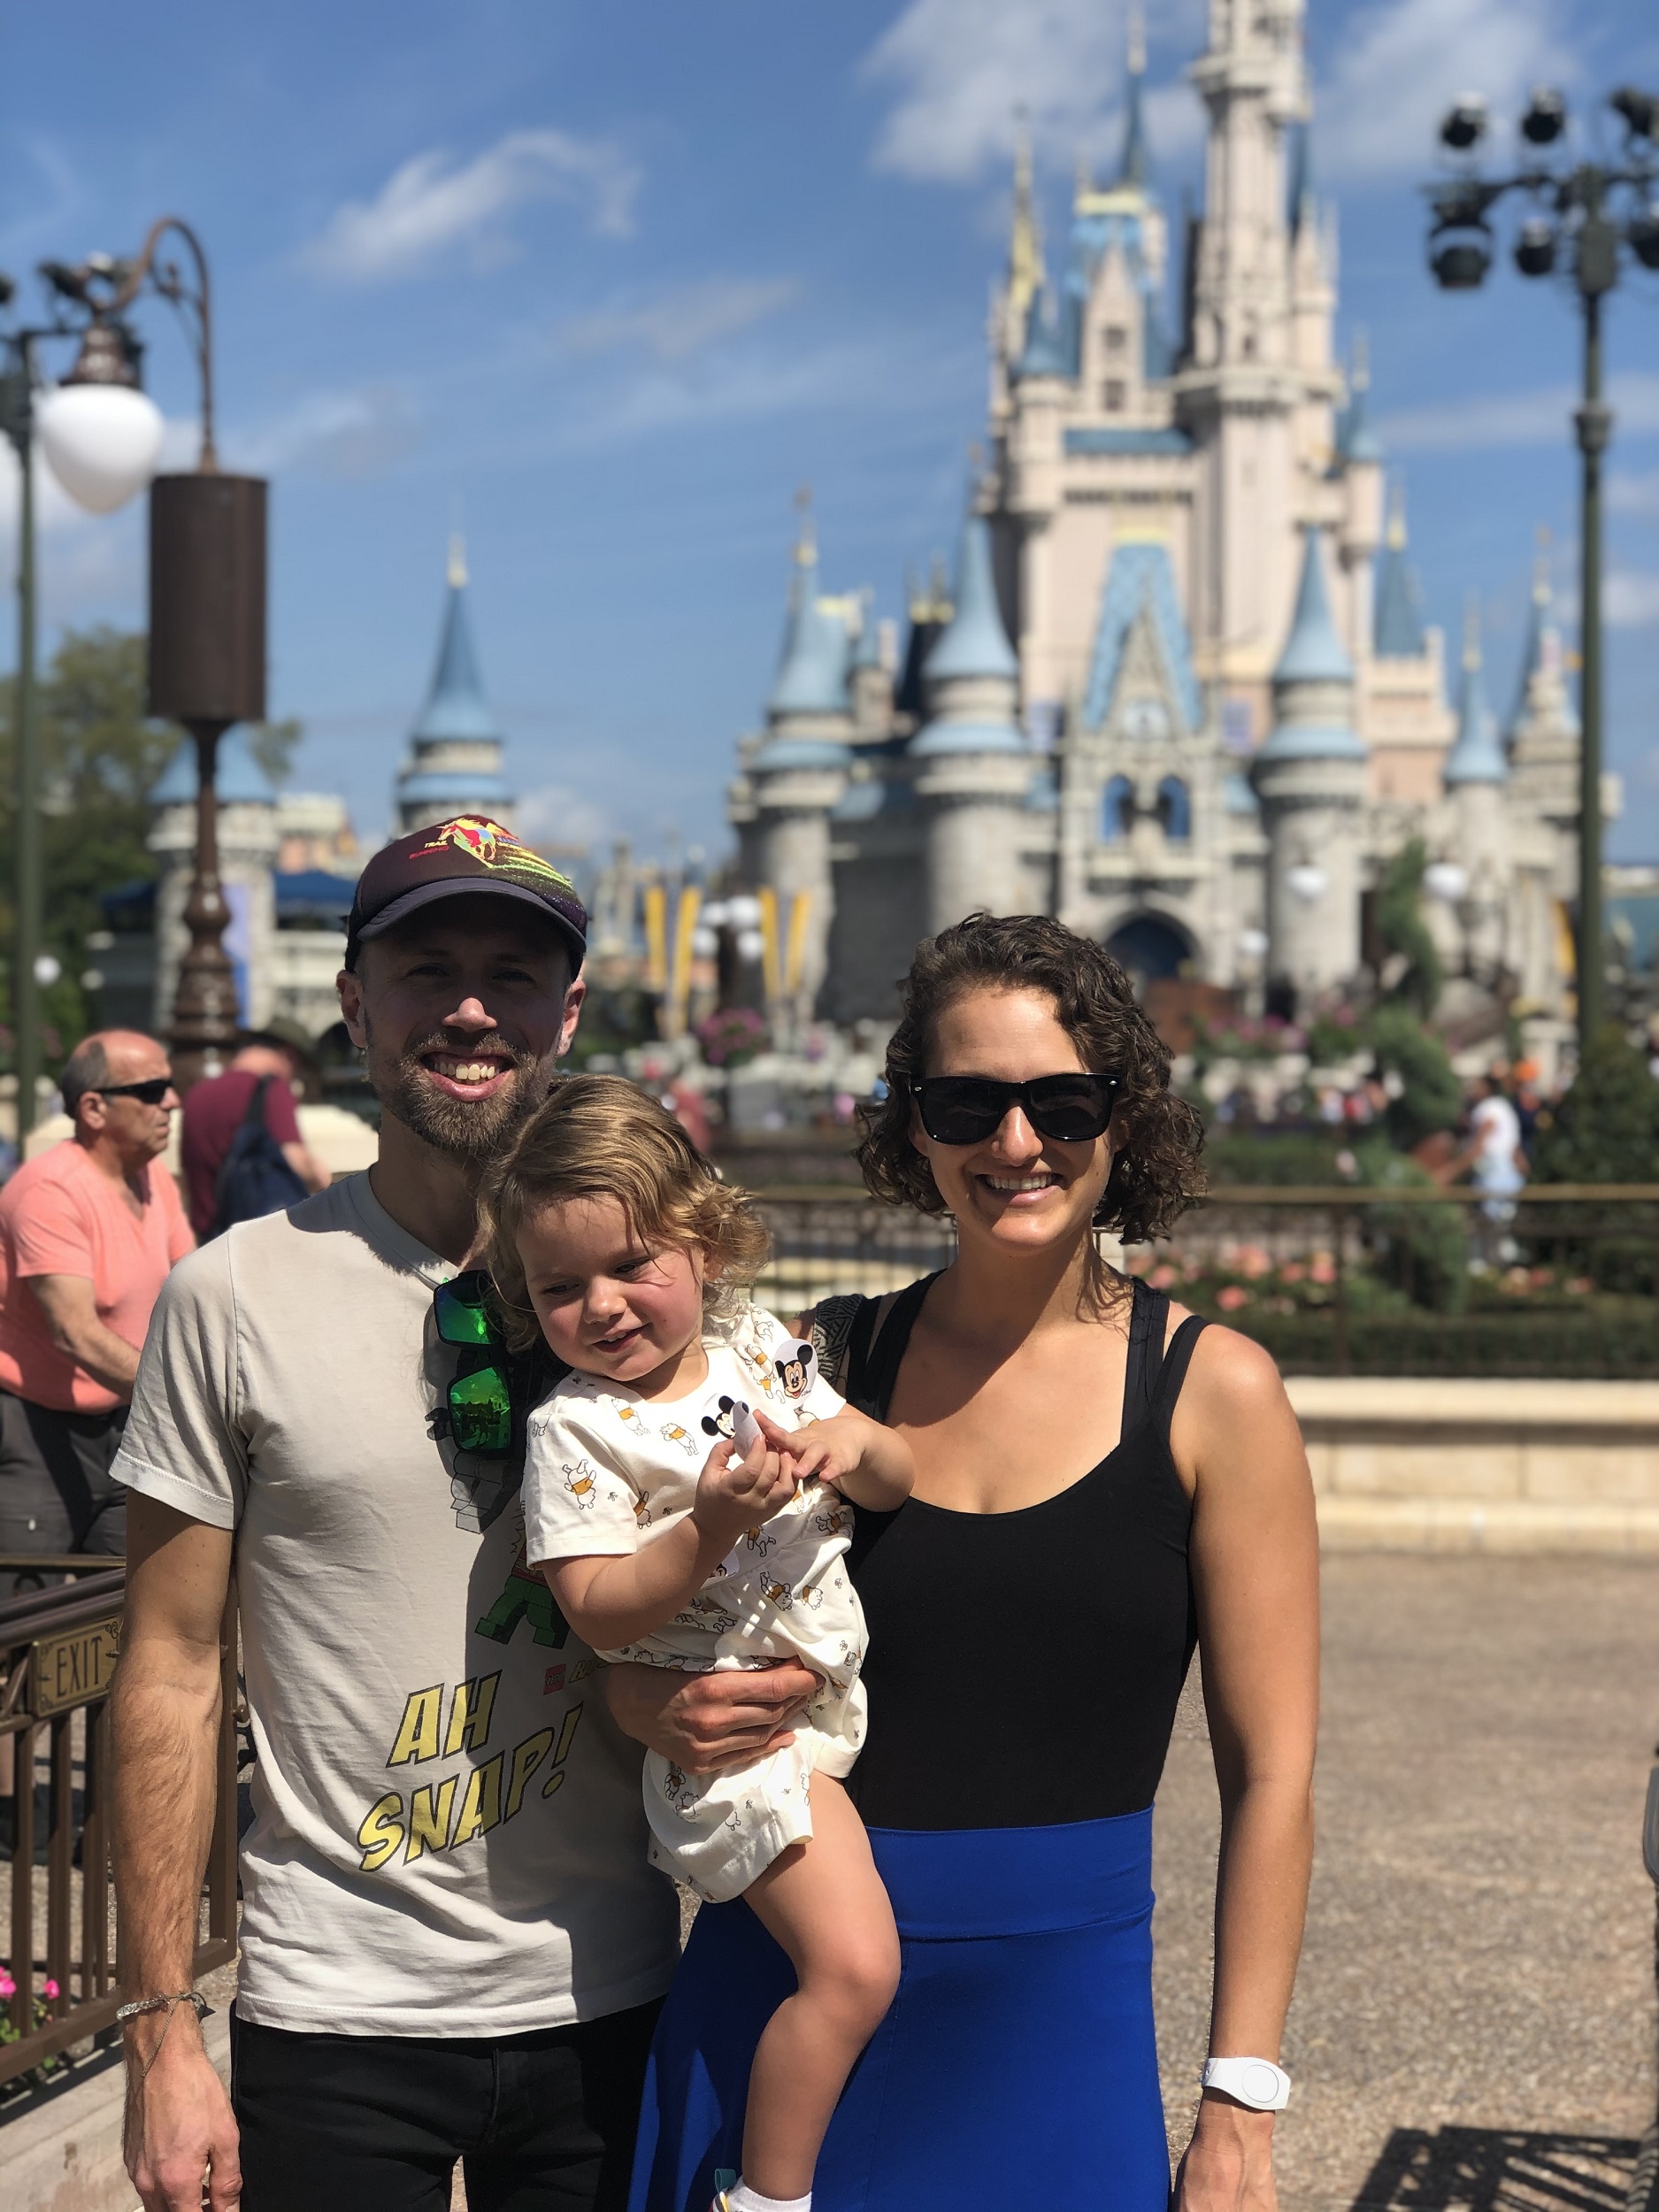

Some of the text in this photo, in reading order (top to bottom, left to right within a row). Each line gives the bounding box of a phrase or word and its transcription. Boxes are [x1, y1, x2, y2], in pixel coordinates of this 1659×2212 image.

[56, 1634, 104, 1698] EXIT
[385, 1669, 503, 1768] AH
[357, 1701, 584, 1871] SNAP!
